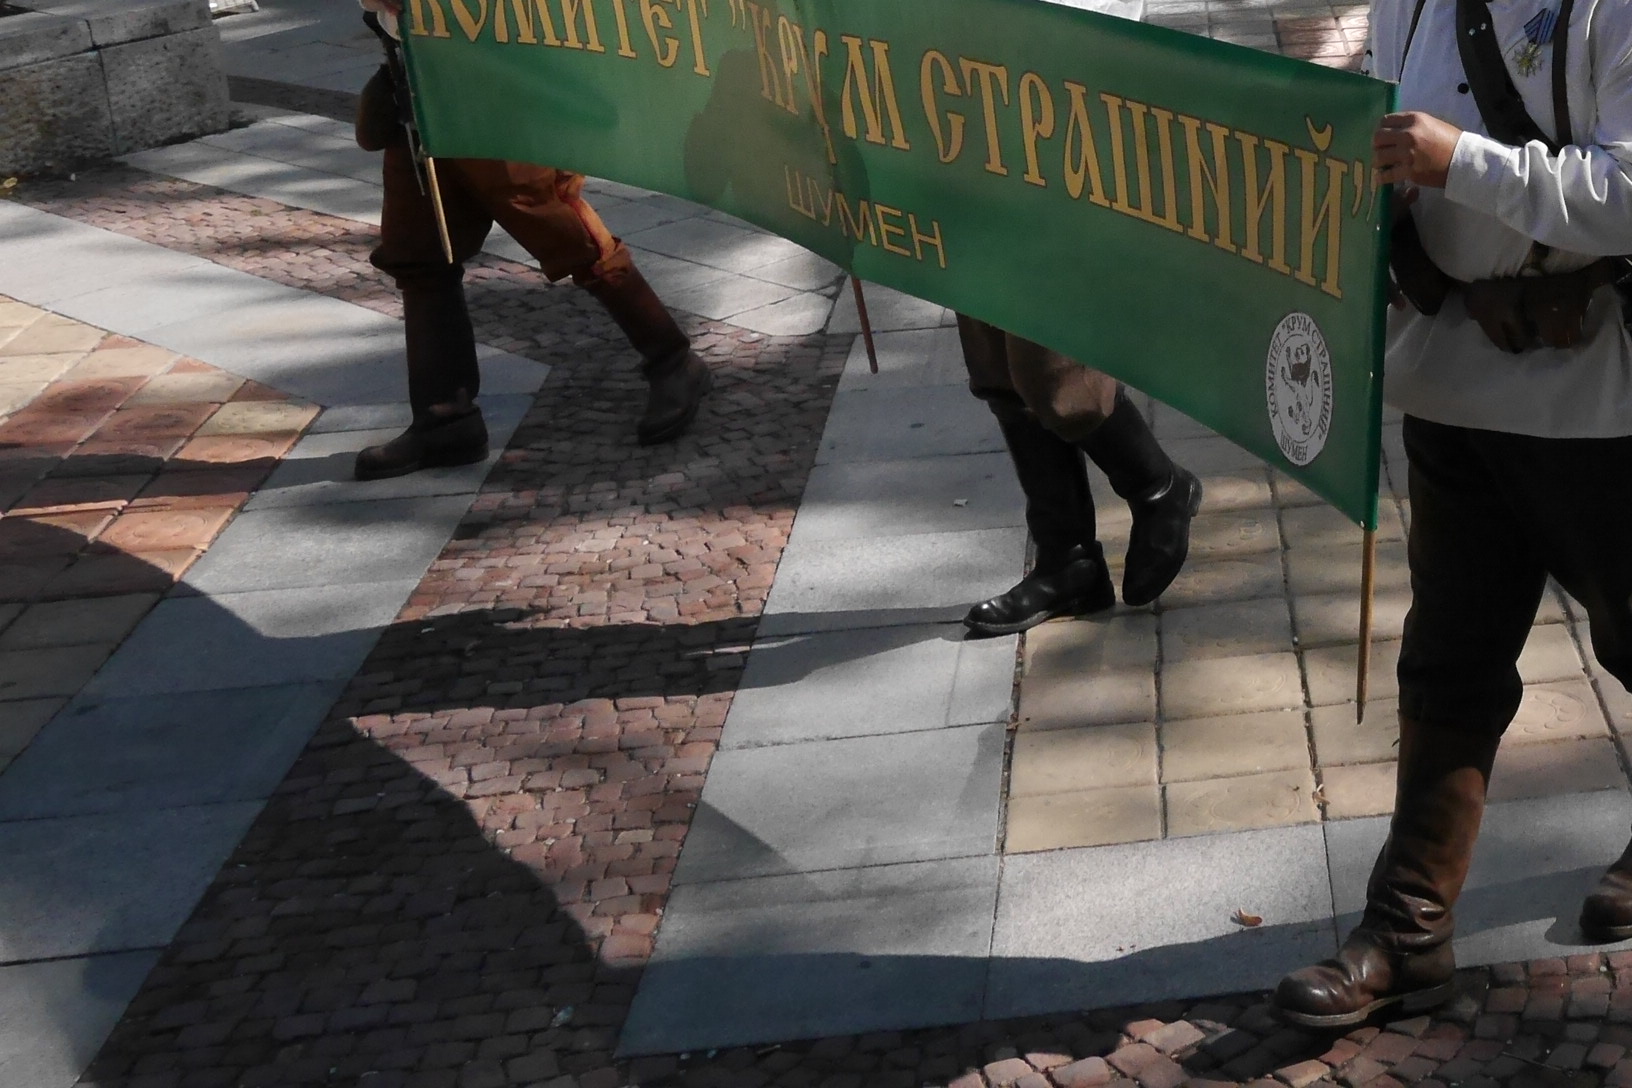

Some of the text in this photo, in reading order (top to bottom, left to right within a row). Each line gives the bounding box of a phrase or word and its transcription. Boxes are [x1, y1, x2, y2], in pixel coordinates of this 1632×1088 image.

[784, 164, 946, 269] ШУМЕН
[1267, 333, 1282, 418] КОМИТЕТ
[1280, 431, 1308, 462] ШУМЕН
